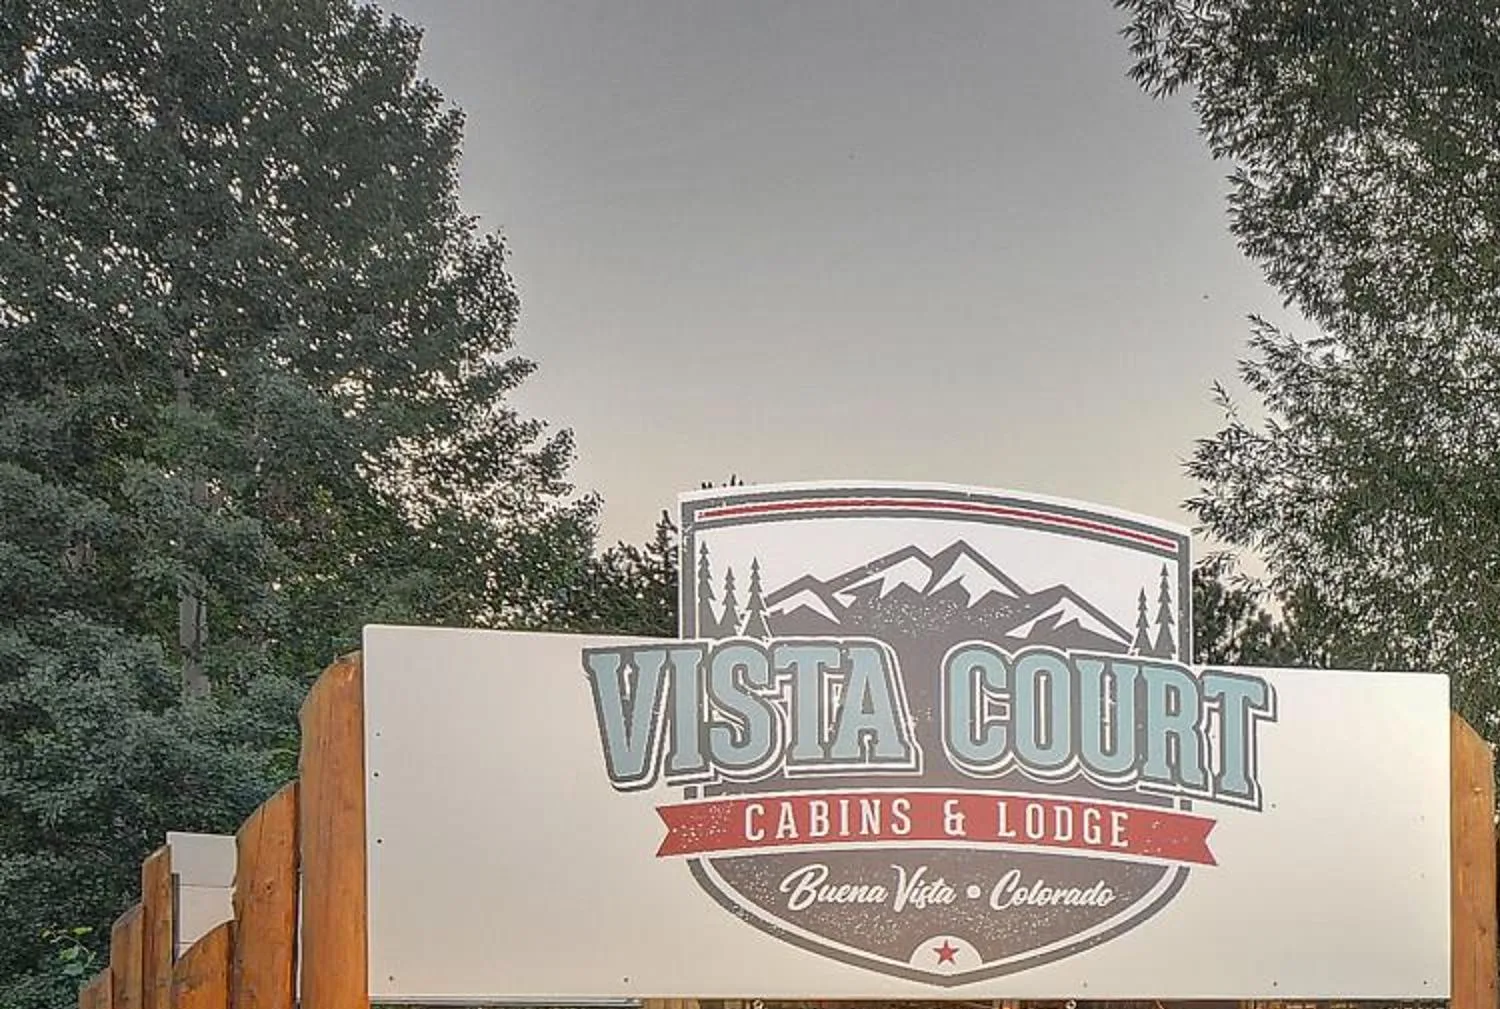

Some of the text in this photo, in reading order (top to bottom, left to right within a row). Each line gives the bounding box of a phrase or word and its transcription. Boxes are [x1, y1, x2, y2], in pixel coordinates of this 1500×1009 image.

[582, 638, 1278, 811] VISTA COURT
[744, 798, 1132, 848] CABINS & LODGE
[780, 864, 1116, 913] Buena Vista Colorado
